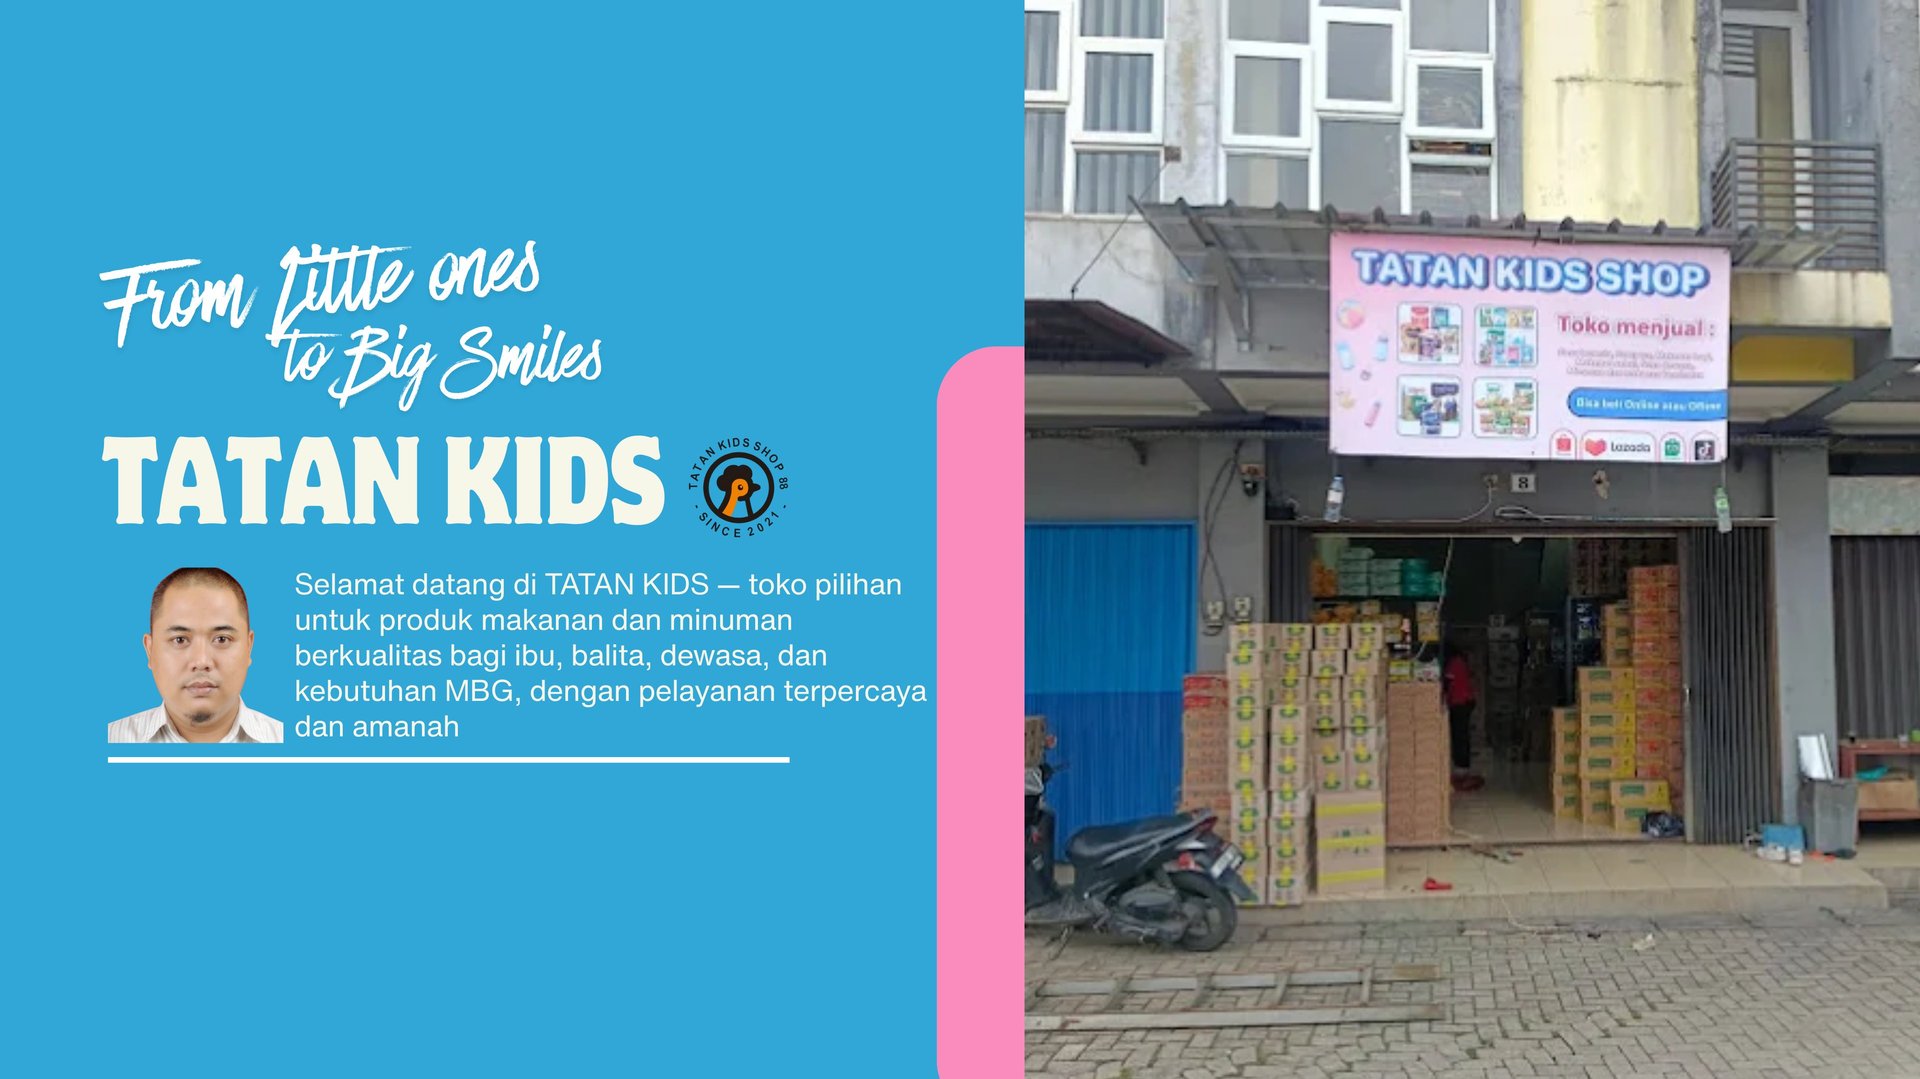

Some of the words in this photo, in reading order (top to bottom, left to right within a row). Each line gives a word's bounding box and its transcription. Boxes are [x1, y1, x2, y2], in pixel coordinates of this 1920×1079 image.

[1352, 249, 1489, 291] TATAN
[1495, 255, 1593, 294] KIDS
[1596, 258, 1711, 298] SHOP
[1558, 315, 1610, 334] Toko
[1616, 316, 1705, 340] menjual
[1611, 441, 1651, 453] Lazada
